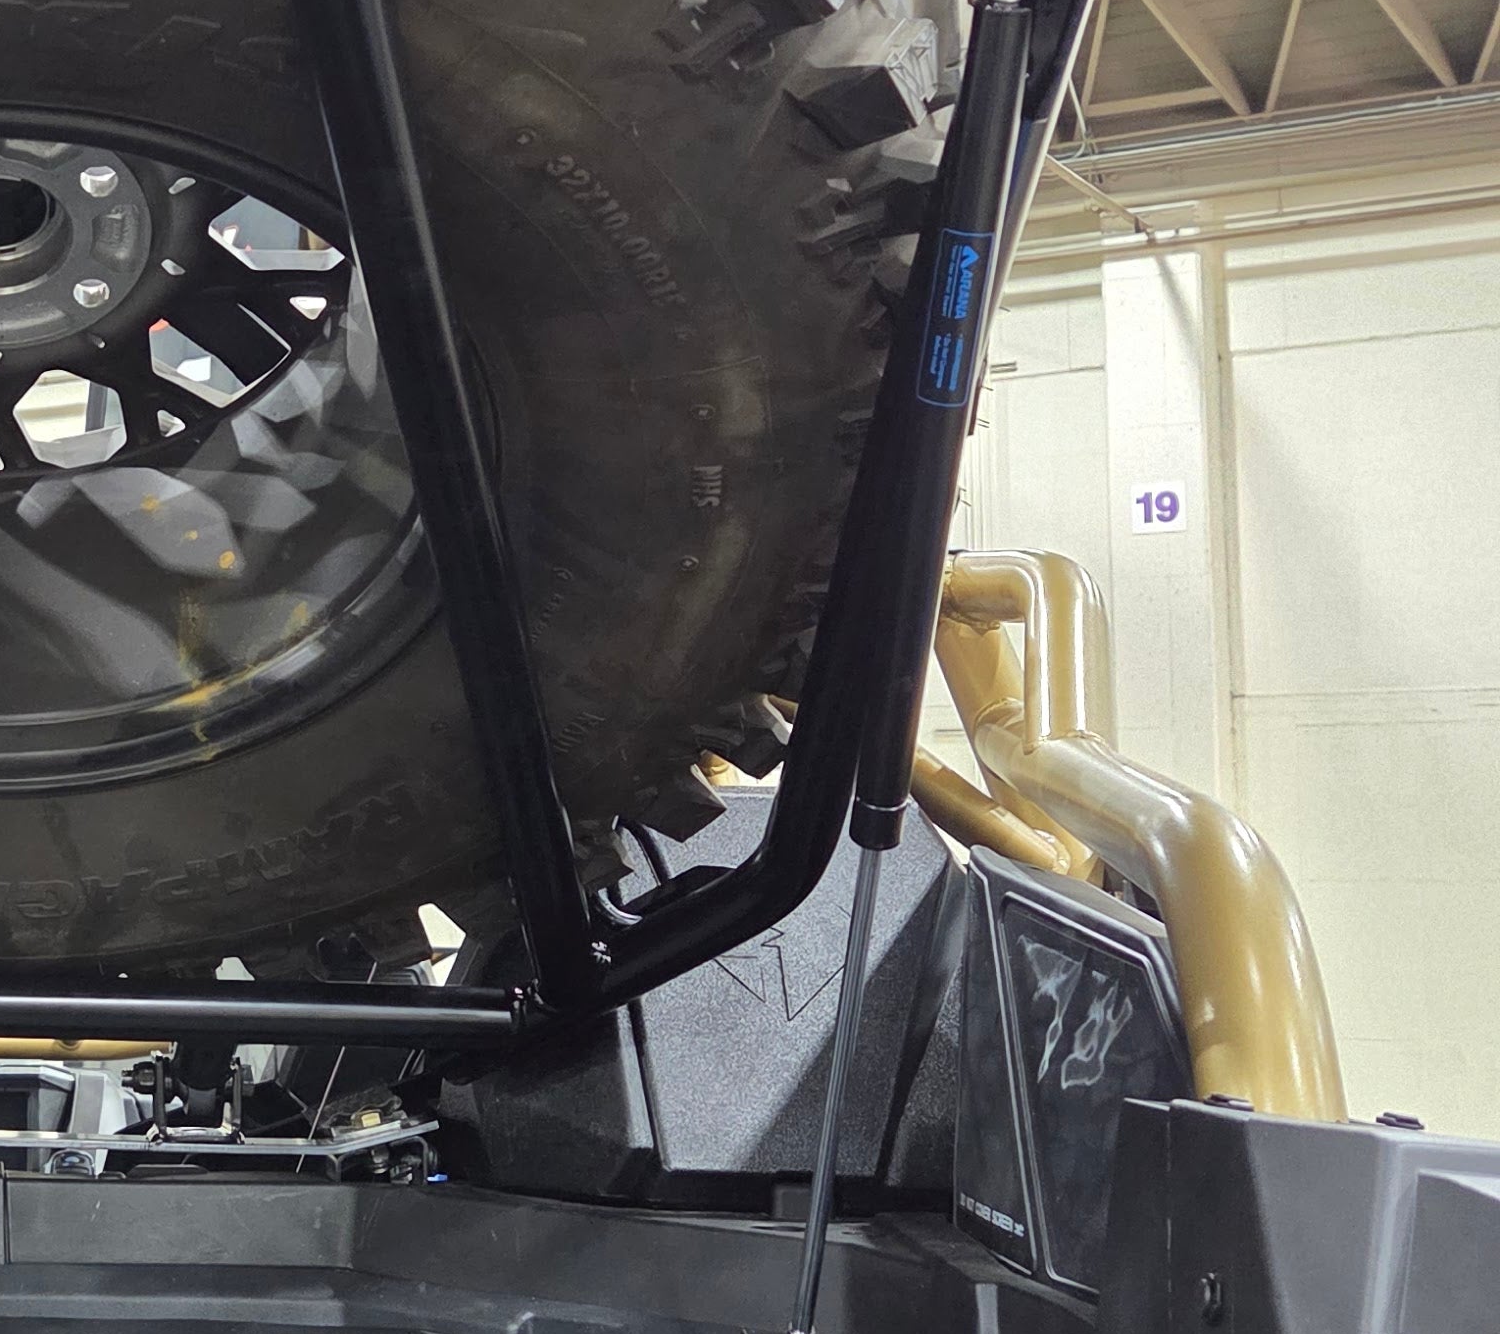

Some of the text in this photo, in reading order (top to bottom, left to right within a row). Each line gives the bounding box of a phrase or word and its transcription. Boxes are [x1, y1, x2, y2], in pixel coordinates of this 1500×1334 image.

[954, 270, 974, 320] ARANA
[691, 464, 723, 508] NHS
[1135, 490, 1181, 524] 19
